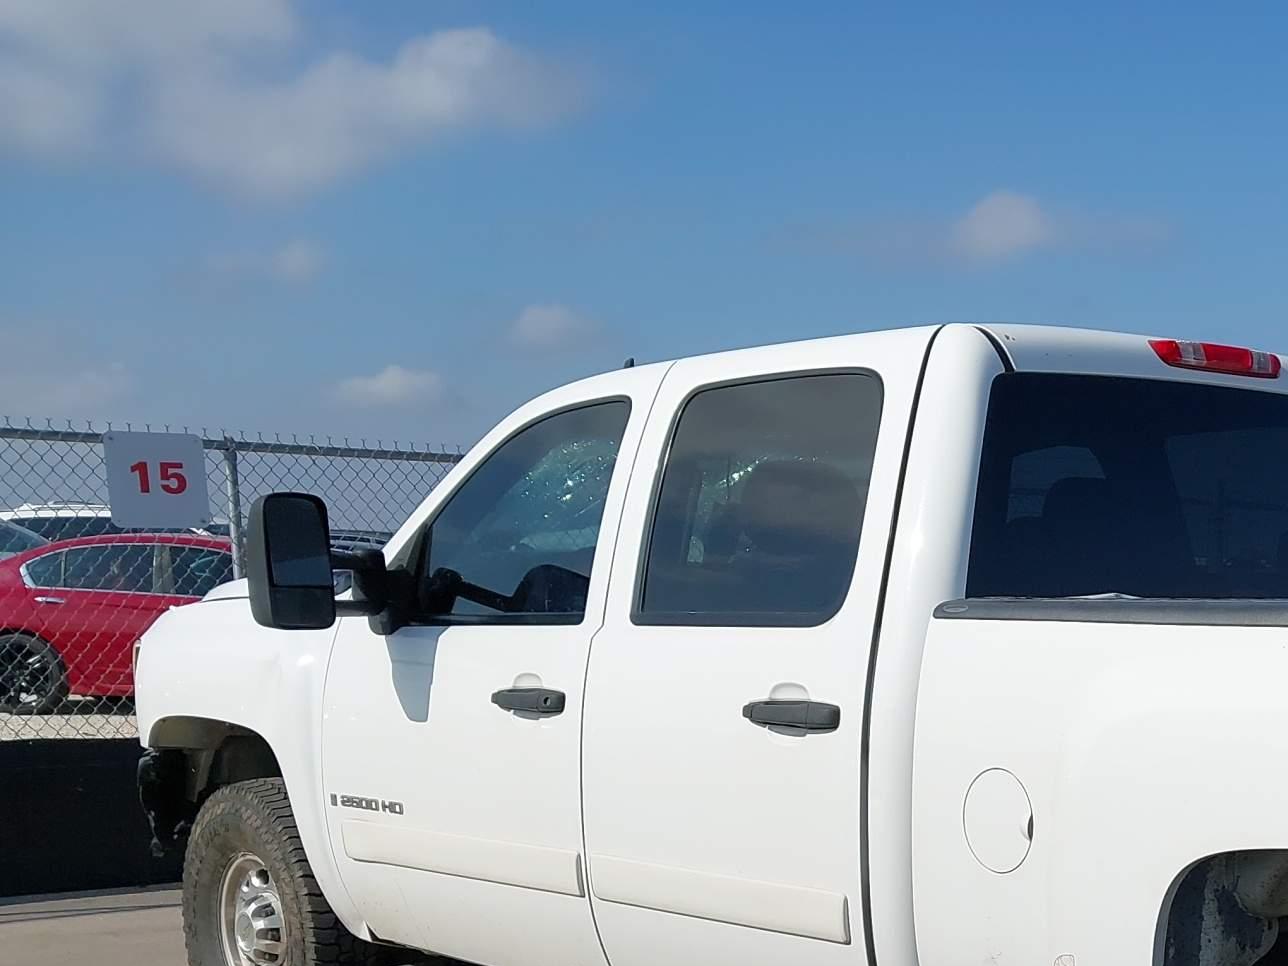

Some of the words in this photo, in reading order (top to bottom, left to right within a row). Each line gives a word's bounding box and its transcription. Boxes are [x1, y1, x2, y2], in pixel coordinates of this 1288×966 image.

[130, 461, 187, 495] 15
[340, 794, 380, 812] 2500
[381, 799, 404, 815] HD
